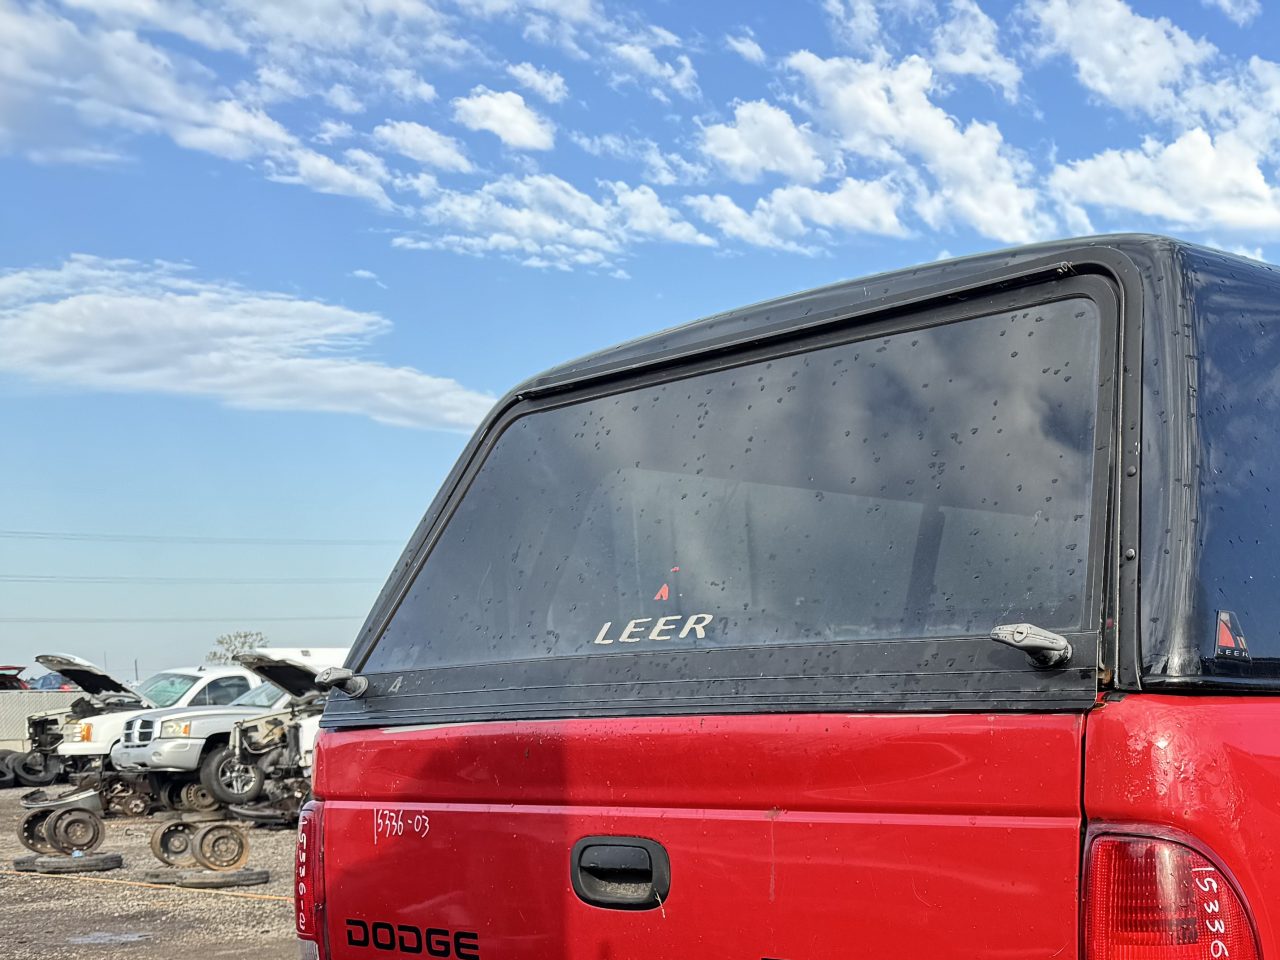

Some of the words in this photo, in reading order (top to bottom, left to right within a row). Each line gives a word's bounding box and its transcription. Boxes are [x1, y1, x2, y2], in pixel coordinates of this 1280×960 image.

[593, 613, 714, 645] LEER
[1217, 648, 1249, 657] LEER
[373, 807, 430, 845] 15336-03
